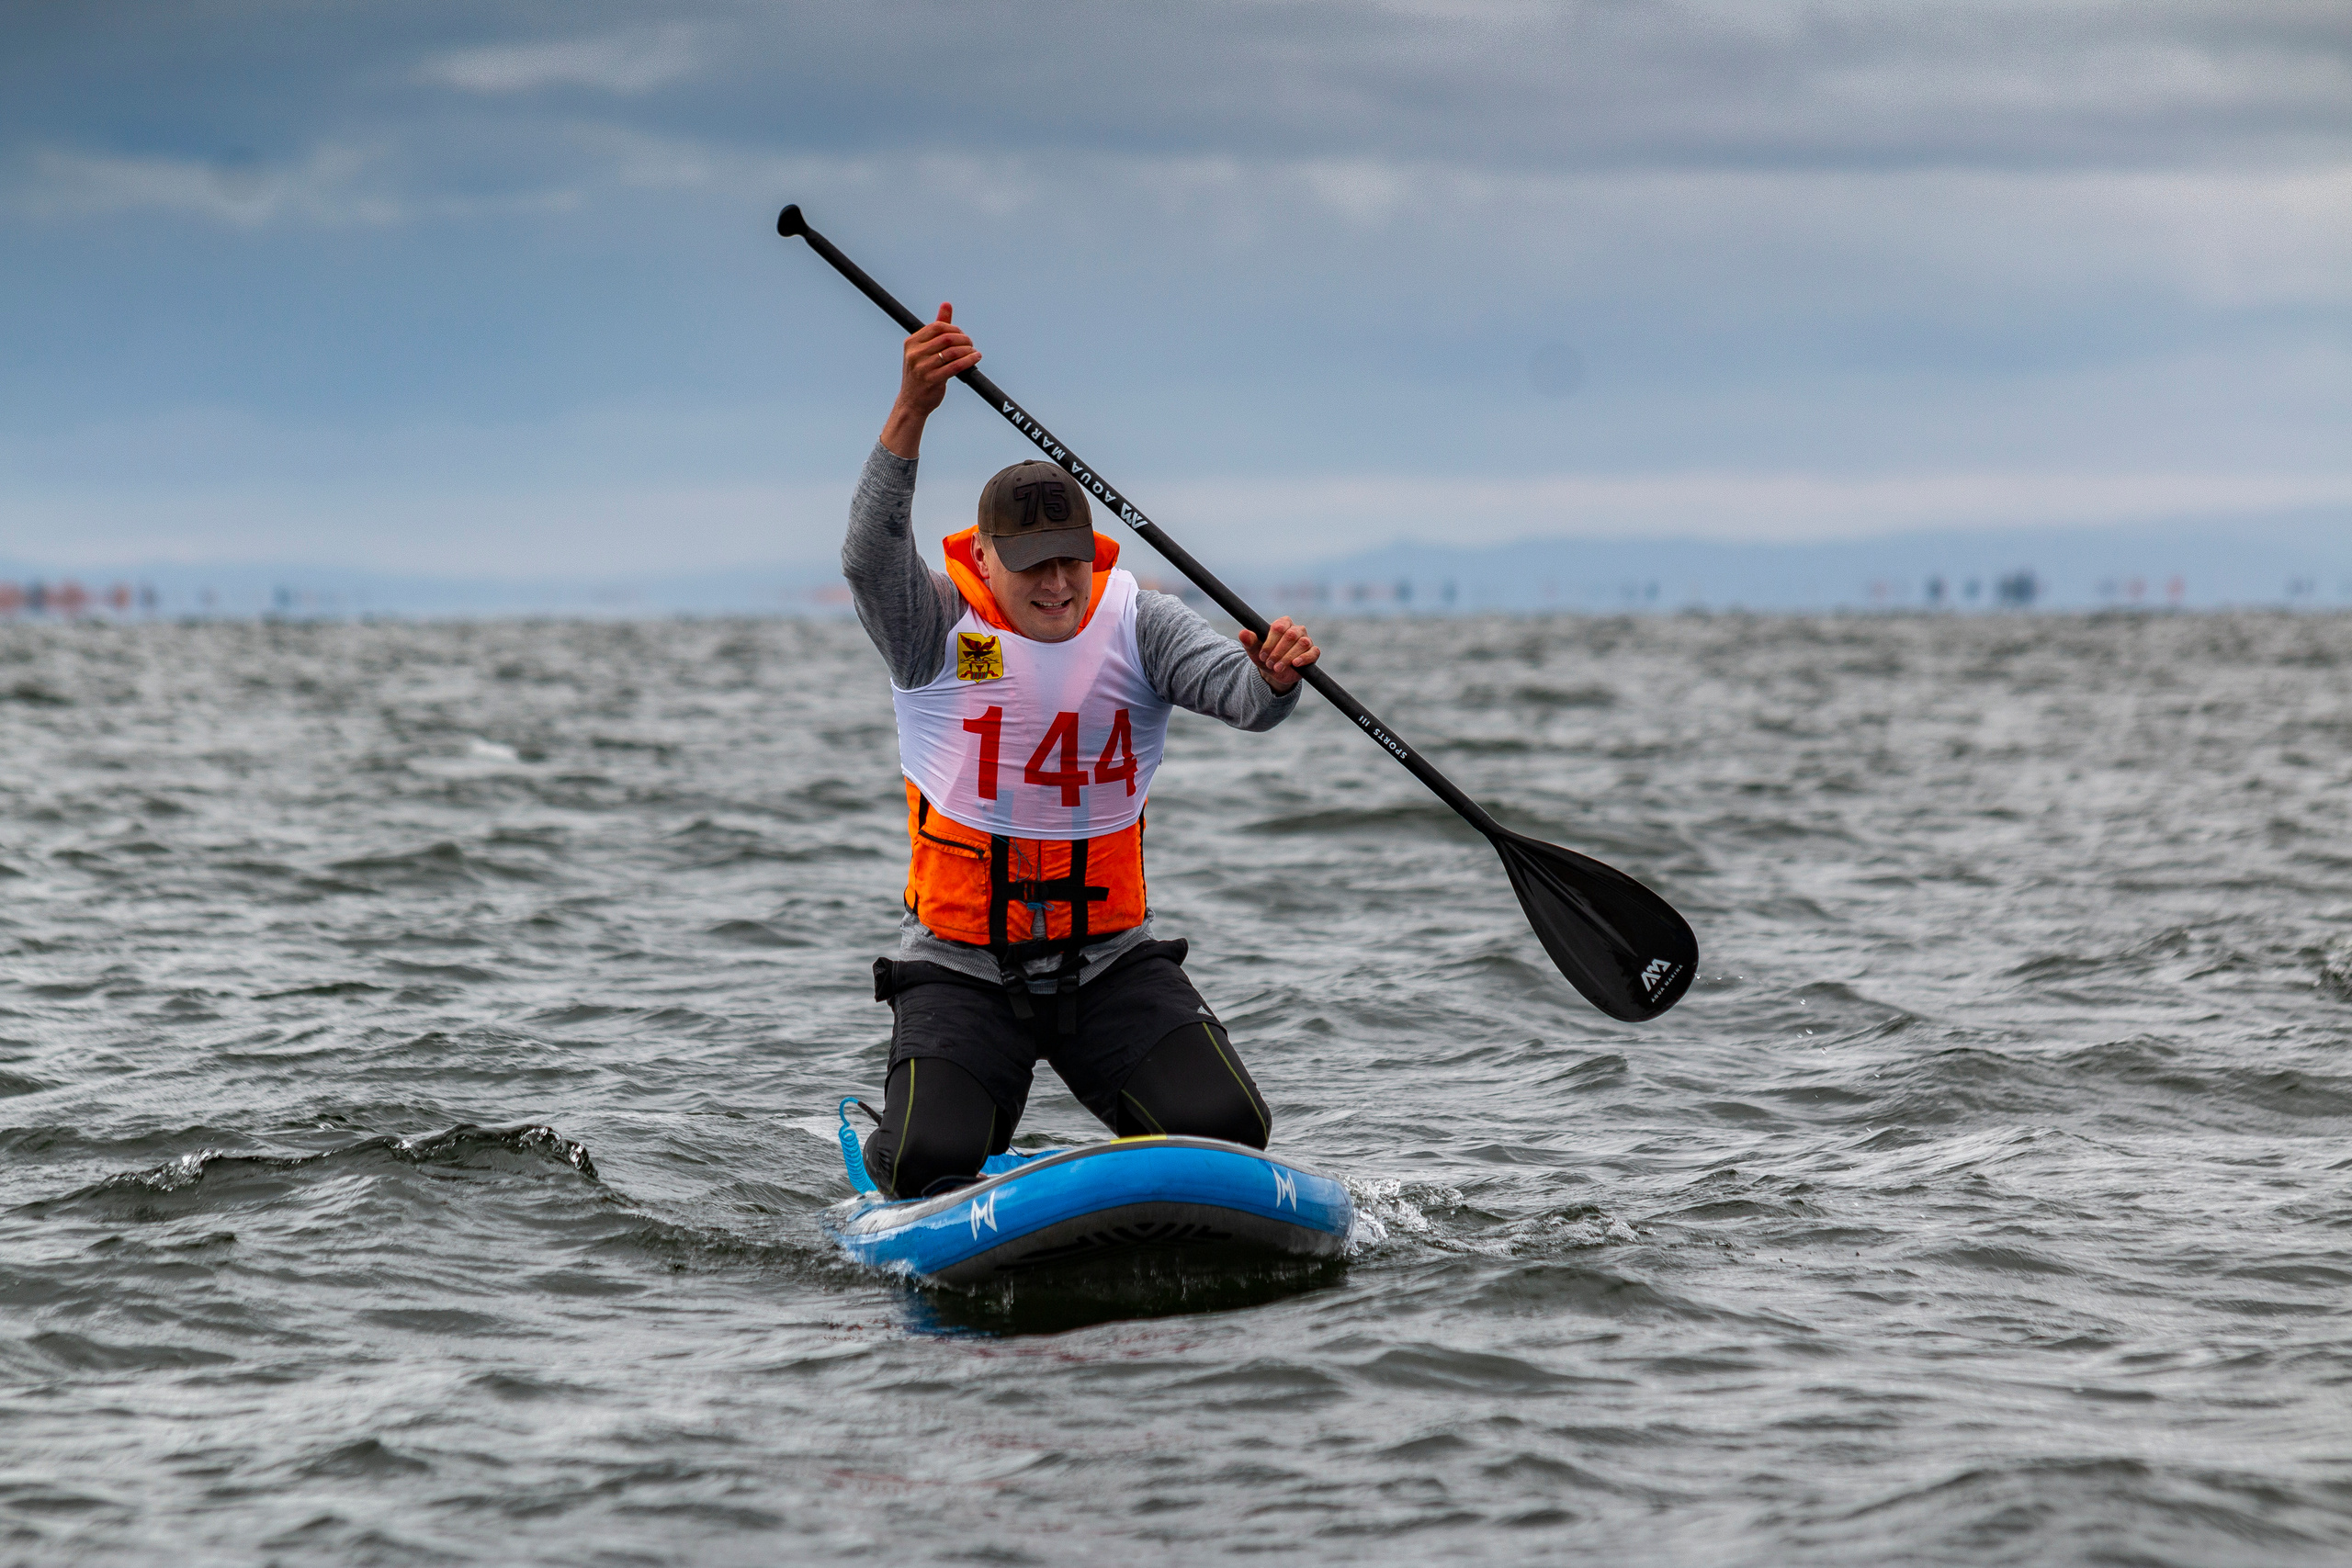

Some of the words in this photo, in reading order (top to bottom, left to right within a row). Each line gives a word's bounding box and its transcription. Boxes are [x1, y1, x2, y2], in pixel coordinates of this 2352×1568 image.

[1002, 400, 1066, 460] MARINA
[1013, 481, 1069, 525] 75
[1071, 461, 1116, 502] AQUA
[963, 705, 1138, 807] 144
[1374, 728, 1408, 759] SPORTS
